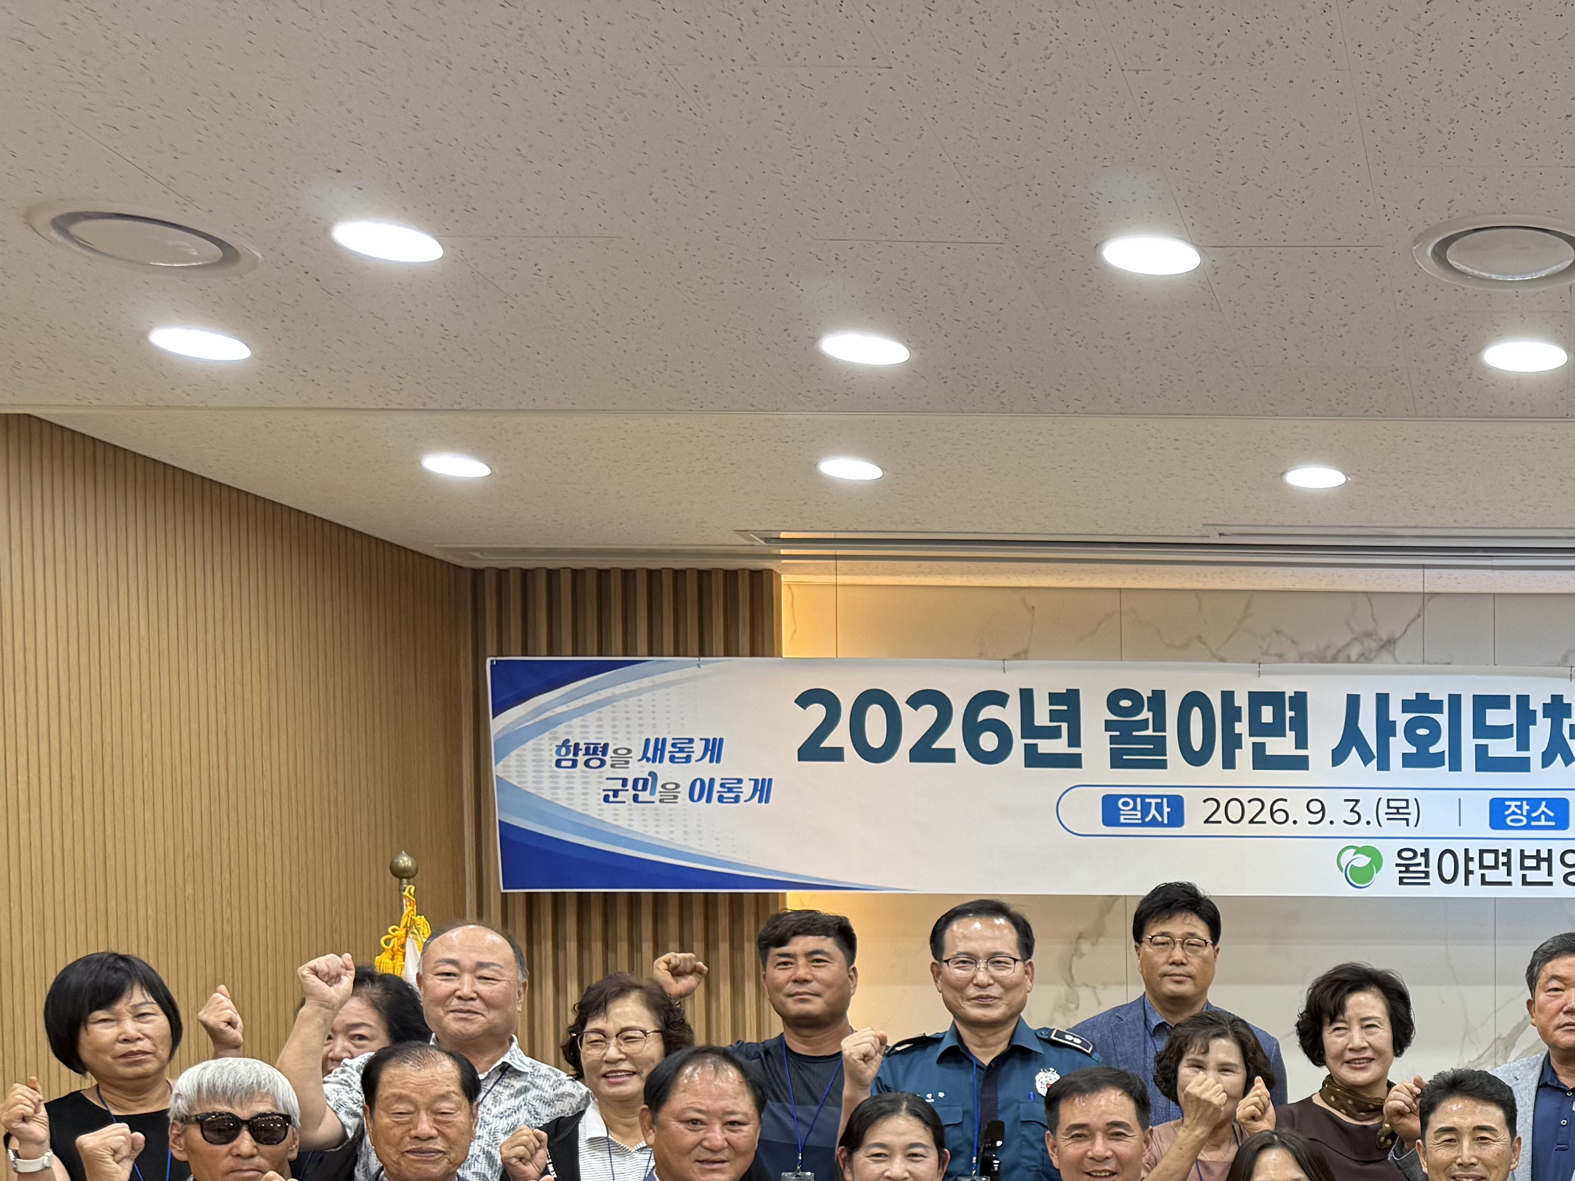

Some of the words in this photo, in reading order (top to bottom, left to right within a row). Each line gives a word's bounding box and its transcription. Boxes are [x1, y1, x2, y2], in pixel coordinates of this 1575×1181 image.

[793, 687, 1083, 770] 2026년
[1103, 687, 1310, 771] 월야면
[554, 738, 633, 770] 함평을
[637, 737, 725, 764] 새롭게
[602, 770, 681, 804] 군민을
[688, 777, 773, 804] 이롭게
[1117, 796, 1171, 824] 일자
[1503, 800, 1556, 827] 장소
